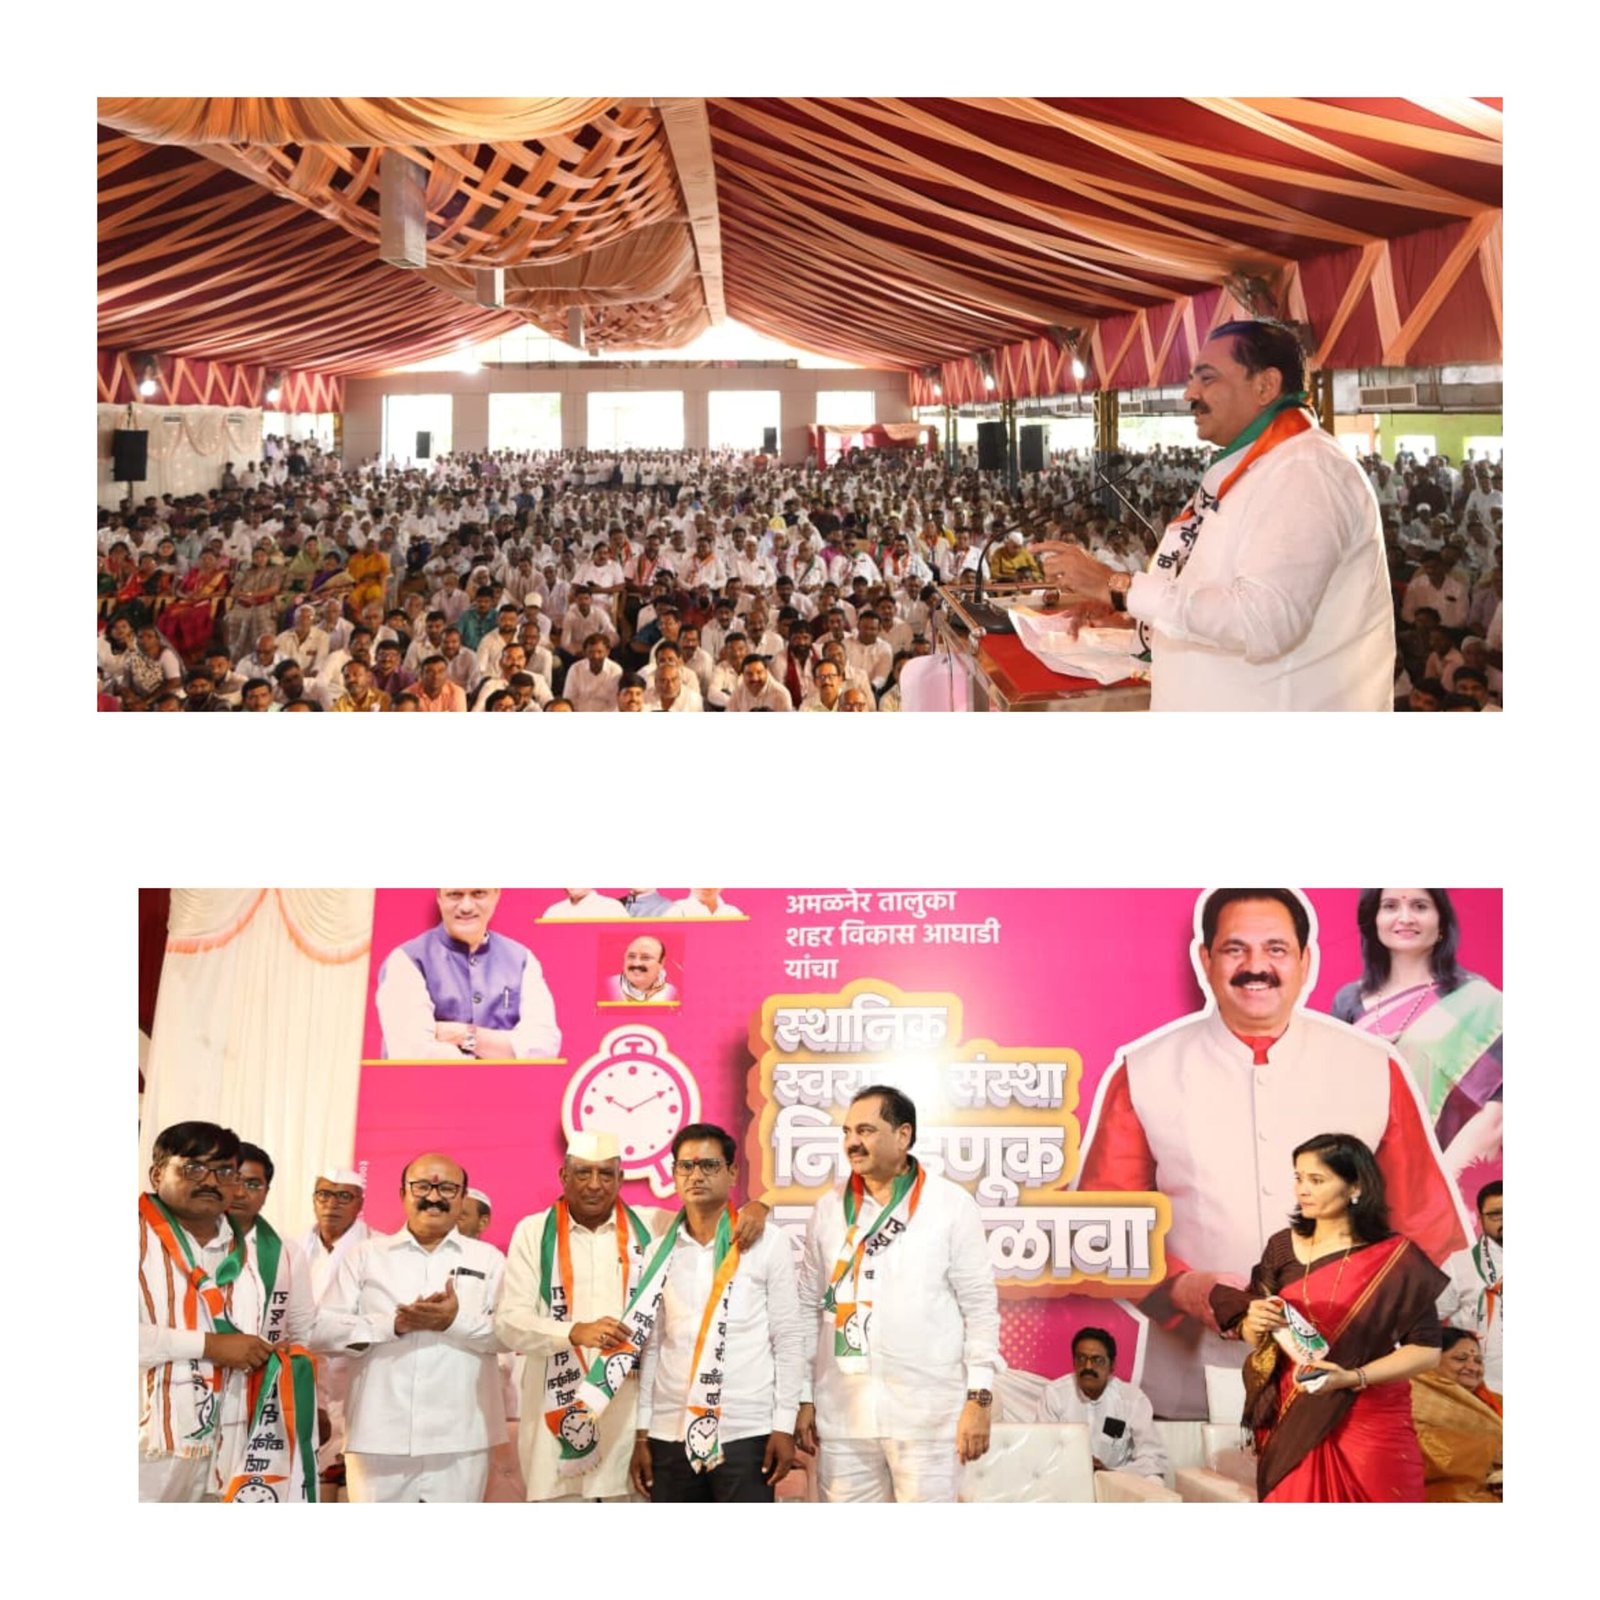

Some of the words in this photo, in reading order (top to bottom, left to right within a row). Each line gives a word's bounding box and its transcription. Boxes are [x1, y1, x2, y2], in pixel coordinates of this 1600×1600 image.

[785, 888, 871, 915] अमळनेर
[877, 890, 957, 919] तालुका
[785, 925, 834, 948] शहर
[839, 918, 917, 945] विकास
[922, 917, 1002, 944] आघाडी
[784, 953, 840, 979] यांचा
[774, 993, 948, 1050] स्थानिक
[951, 1054, 1067, 1108] संस्था
